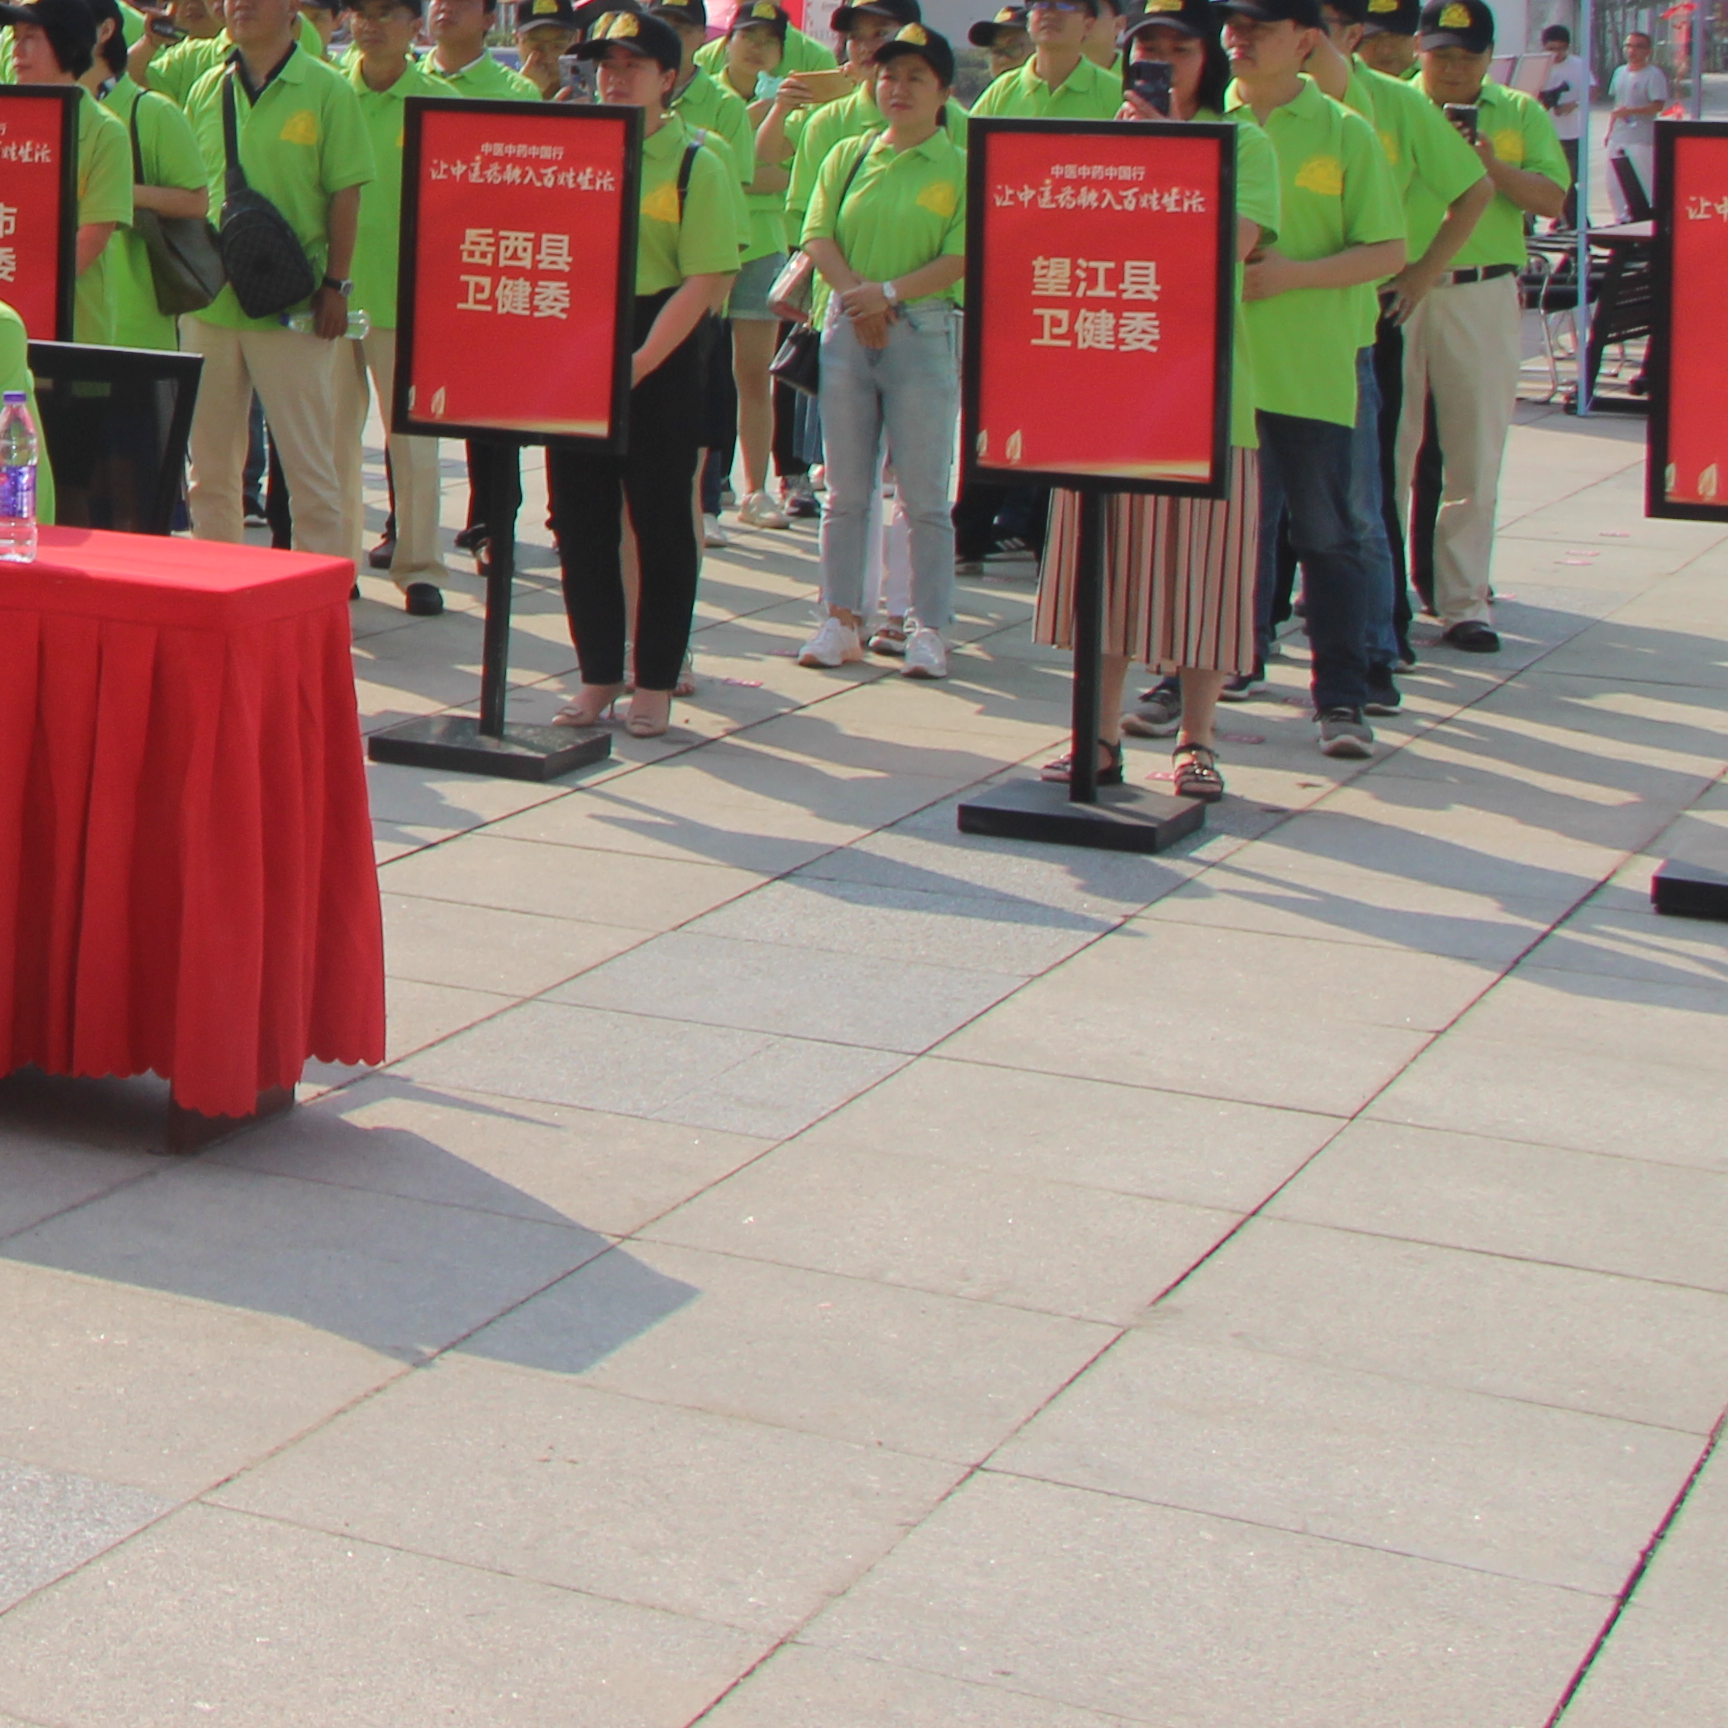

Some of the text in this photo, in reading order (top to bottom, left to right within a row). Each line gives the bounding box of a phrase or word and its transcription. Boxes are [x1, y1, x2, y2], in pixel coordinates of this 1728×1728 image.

[480, 141, 565, 160] 中医中药中国行
[1050, 163, 1146, 181] 中医中药中国行
[459, 227, 573, 272] 岳西县
[456, 274, 571, 319] 卫健委
[1030, 255, 1162, 302] 望江县
[1030, 307, 1162, 353] 卫健委
